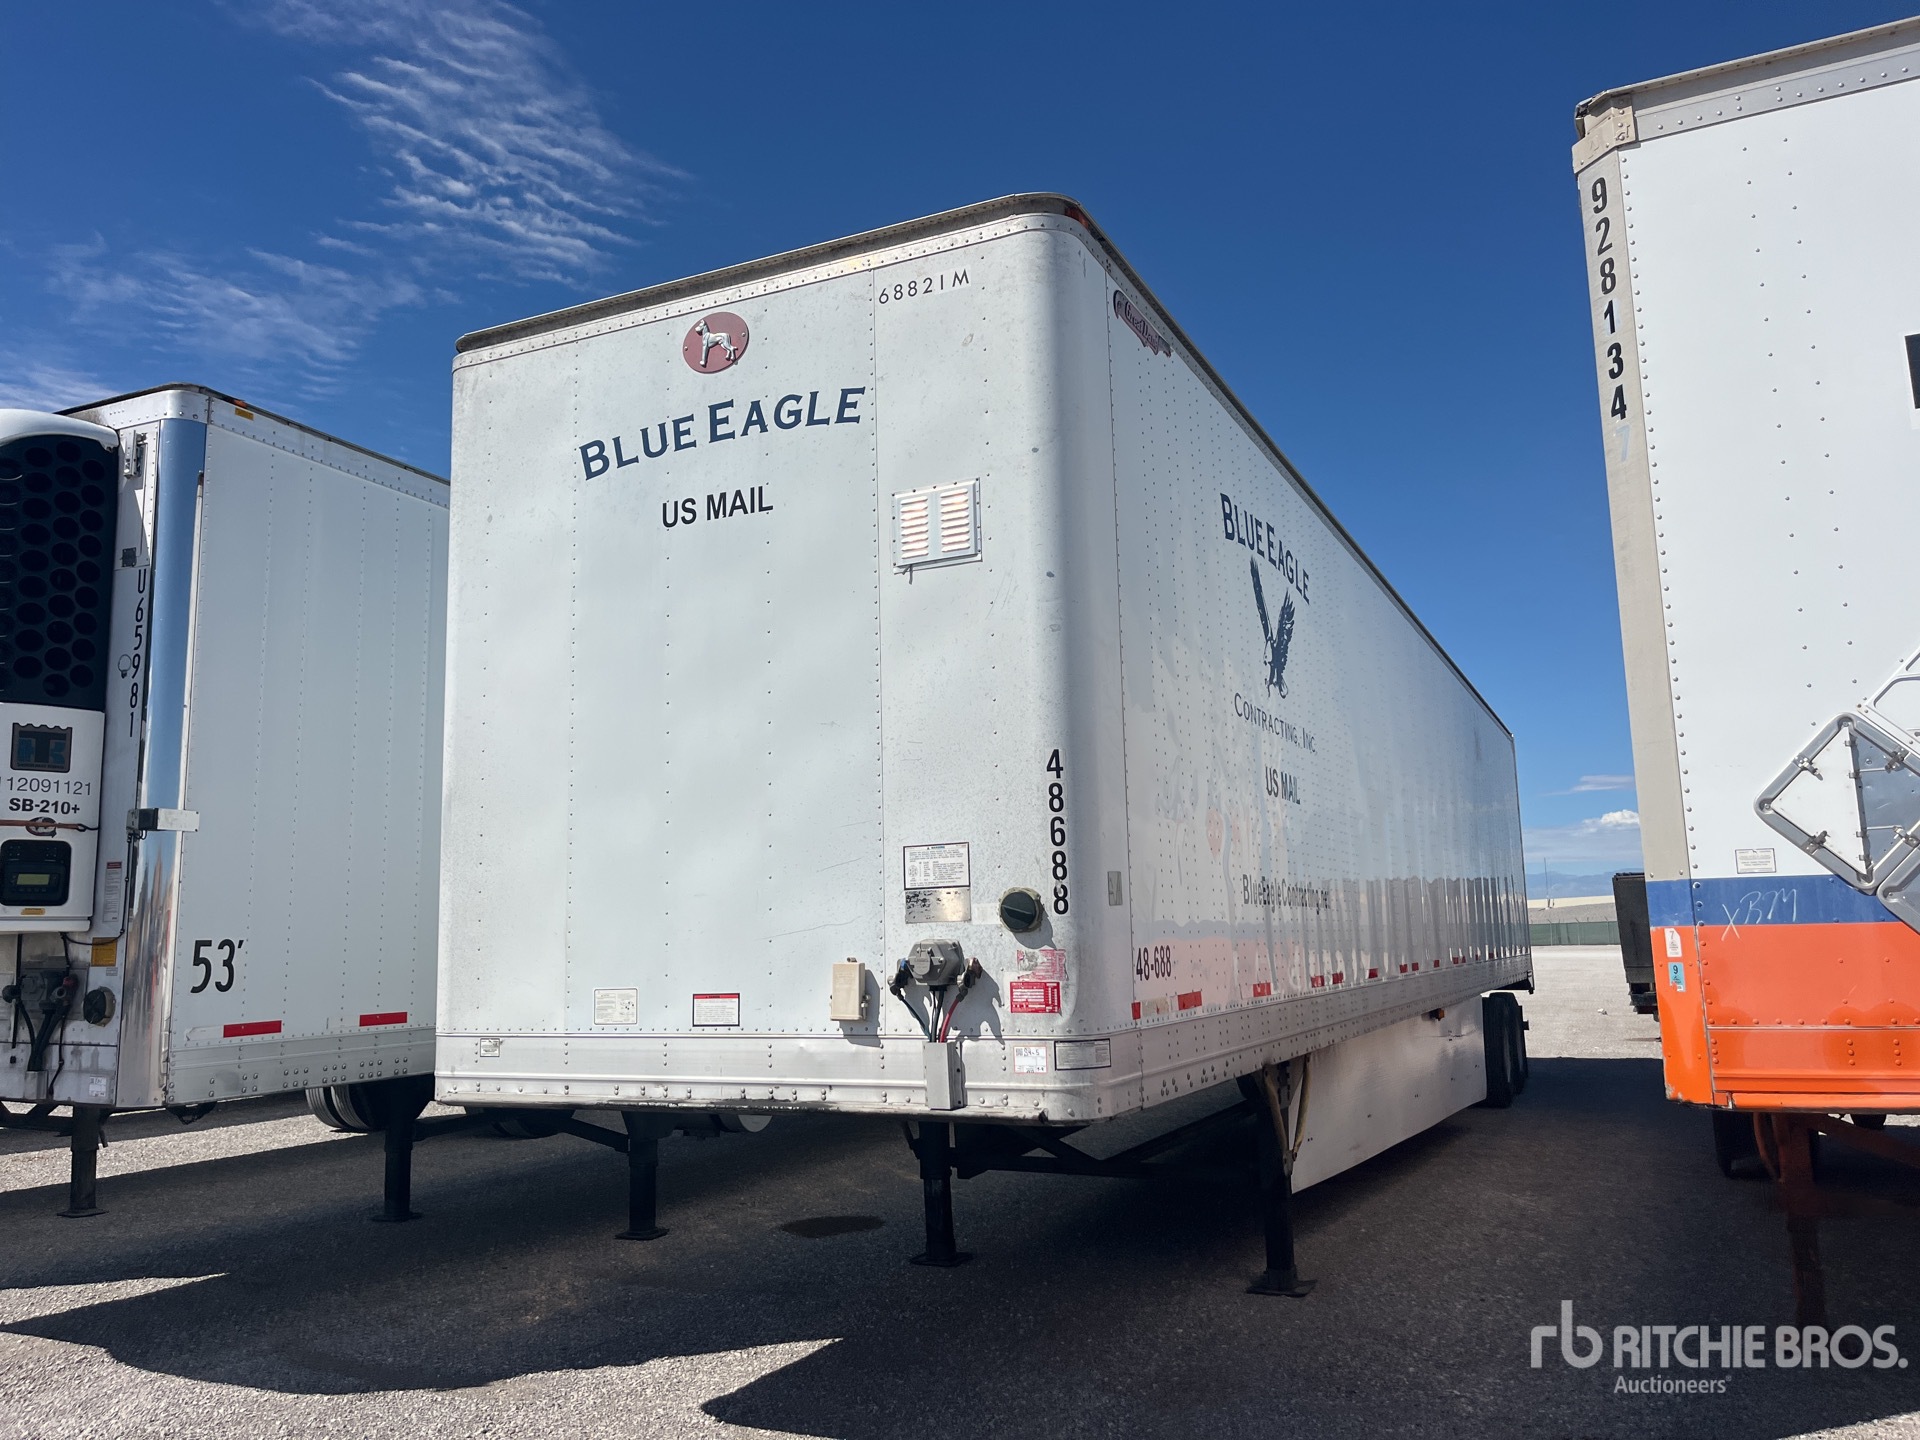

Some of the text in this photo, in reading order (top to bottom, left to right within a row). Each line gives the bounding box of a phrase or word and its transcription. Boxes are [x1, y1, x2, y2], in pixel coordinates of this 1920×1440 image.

[878, 269, 970, 305] 68821M
[579, 386, 866, 481] BLUE EAGLE
[662, 486, 774, 528] US MAIL
[1220, 493, 1310, 605] BLUE EAGLE
[1265, 766, 1301, 805] US MAIL
[8, 797, 80, 815] SB-210+
[1136, 945, 1172, 981] 48-688
